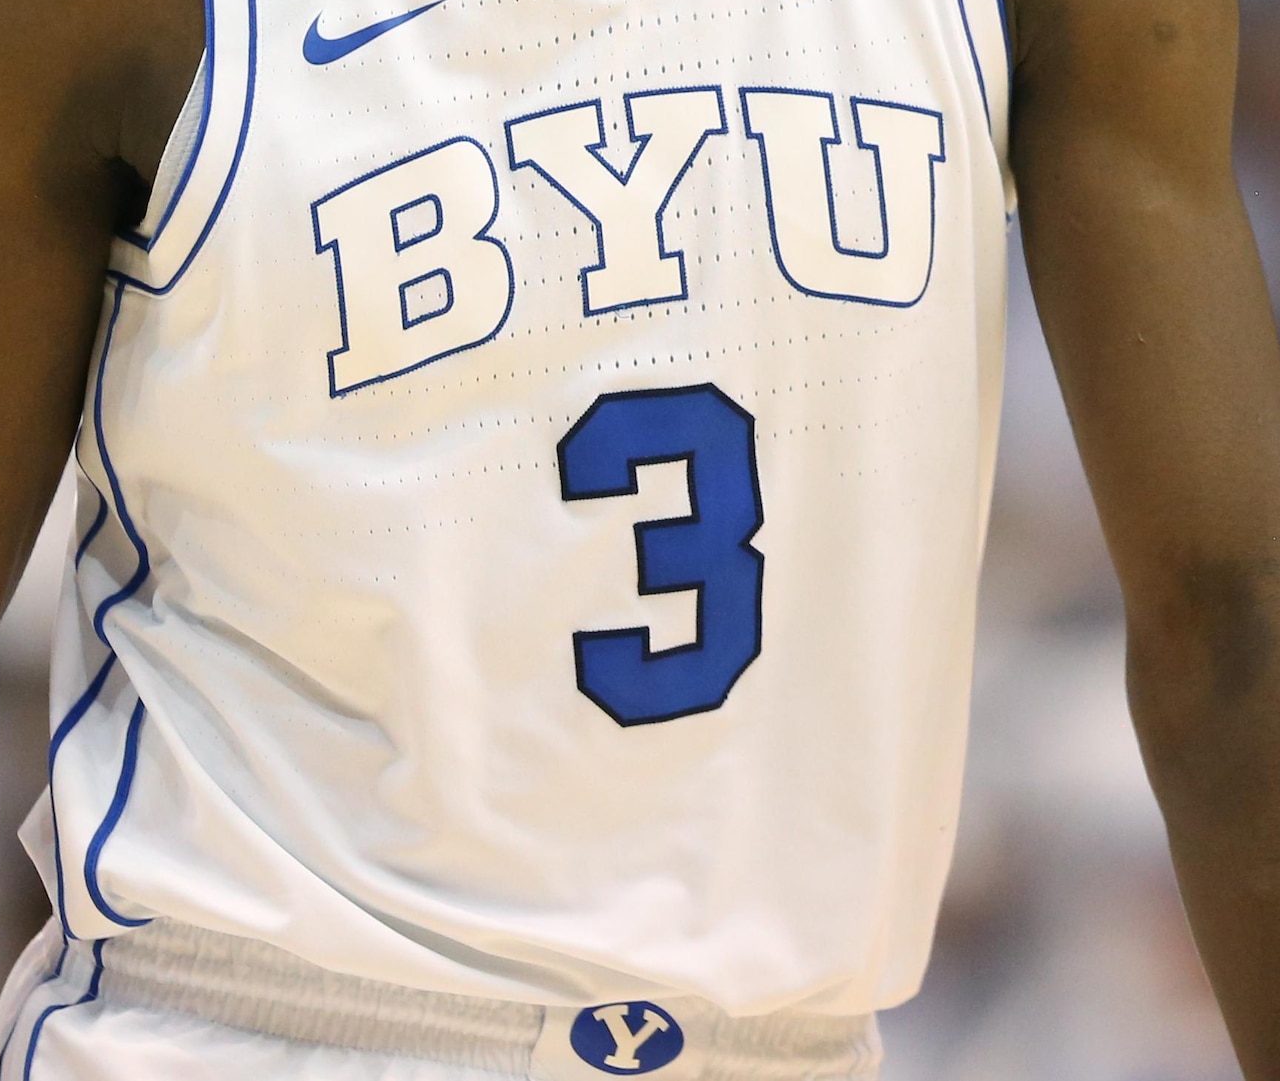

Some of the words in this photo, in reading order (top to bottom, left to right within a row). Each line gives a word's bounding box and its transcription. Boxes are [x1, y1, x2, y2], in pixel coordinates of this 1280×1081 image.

[311, 86, 945, 397] BYU
[557, 383, 764, 727] 3
[592, 1004, 670, 1069] Y
